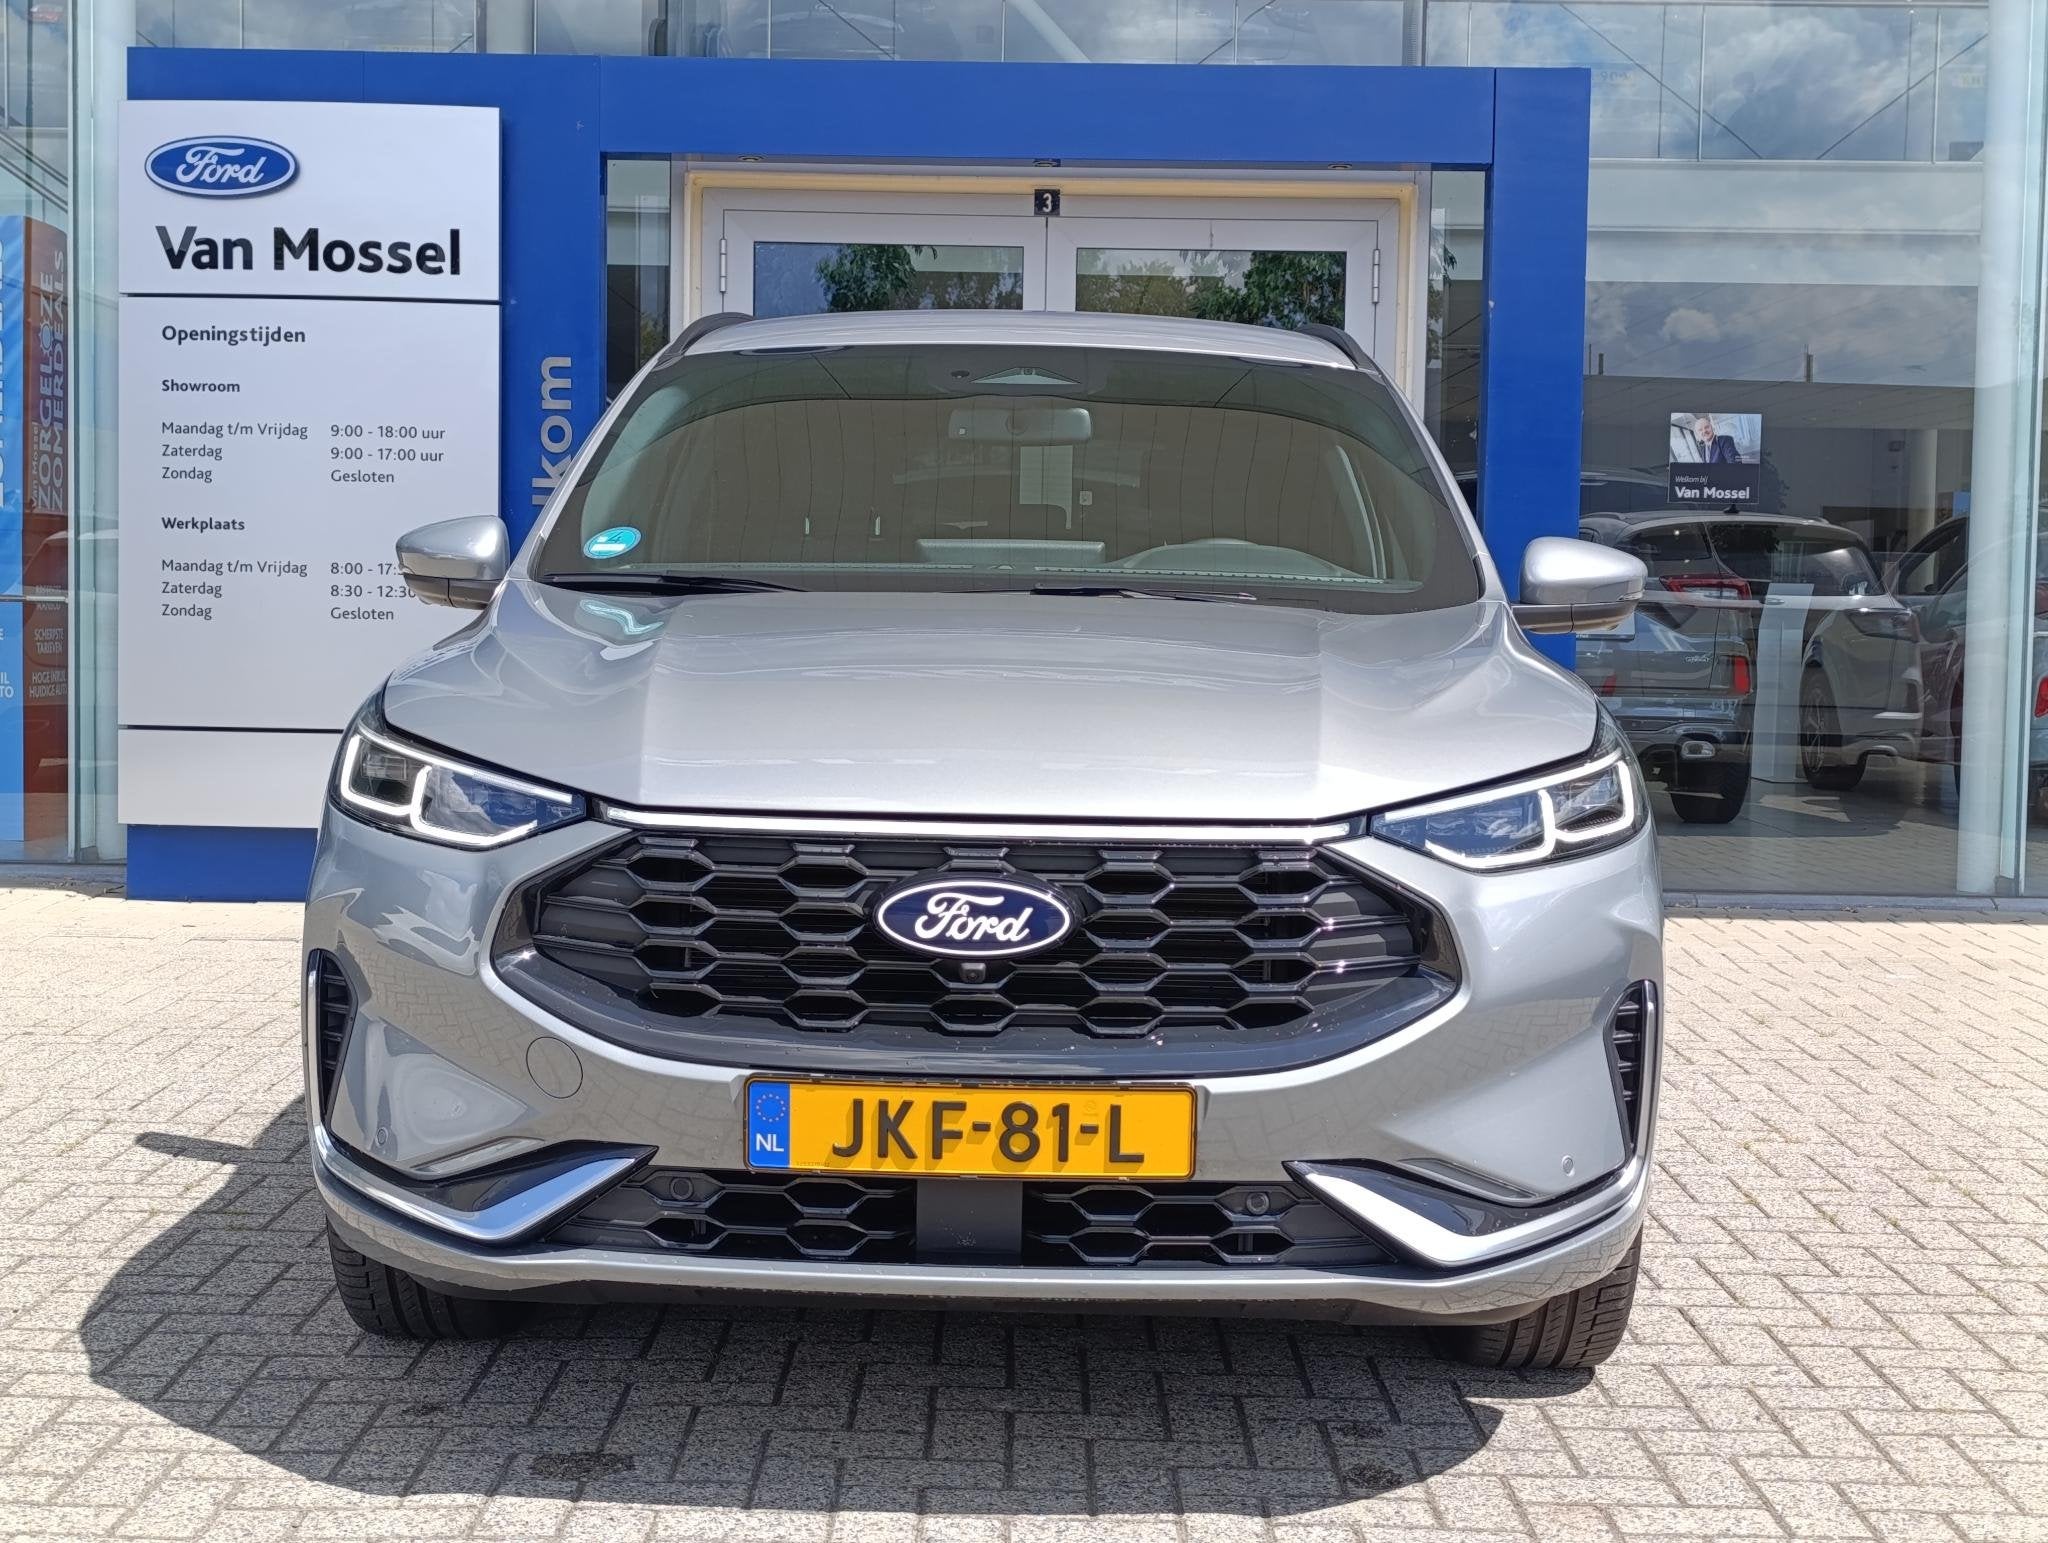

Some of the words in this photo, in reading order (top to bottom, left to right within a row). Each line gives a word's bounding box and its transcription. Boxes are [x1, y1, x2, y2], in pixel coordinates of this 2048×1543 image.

[176, 146, 265, 184] Ford
[1042, 193, 1052, 212] 3
[155, 225, 254, 271] Van
[273, 226, 461, 276] Mossel
[161, 324, 306, 347] Openingstijden
[51, 250, 64, 512] ZOMERDEALS
[161, 378, 241, 394] Showroom
[161, 421, 224, 440] Maandag
[227, 421, 254, 436] t/m
[257, 422, 308, 441] Vrijdag
[330, 424, 364, 439] 9:00
[377, 425, 418, 440] 18:00
[421, 429, 446, 440] uur
[161, 443, 223, 462] Zaterdag
[330, 447, 364, 461] 9:00
[377, 447, 417, 462] 17:00
[420, 452, 445, 462] uur
[161, 465, 213, 484] Zondag
[330, 469, 395, 484] Gesloten
[1675, 475, 1699, 483] Welkom
[1700, 475, 1709, 485] bij
[1675, 486, 1700, 499] Van
[1703, 486, 1750, 499] Mossel
[161, 516, 246, 534] Werkplaats
[161, 558, 224, 577] Maandag
[227, 559, 253, 574] t/m
[257, 560, 308, 578] Vrijdag
[330, 561, 364, 576] 8:00
[161, 581, 223, 599] Zaterdag
[330, 584, 363, 599] 8:30
[161, 603, 213, 621] Zondag
[330, 606, 394, 621] Gesloten
[914, 892, 1031, 942] Ford
[755, 1134, 784, 1153] NL
[831, 1098, 1145, 1164] JKF-81-L
